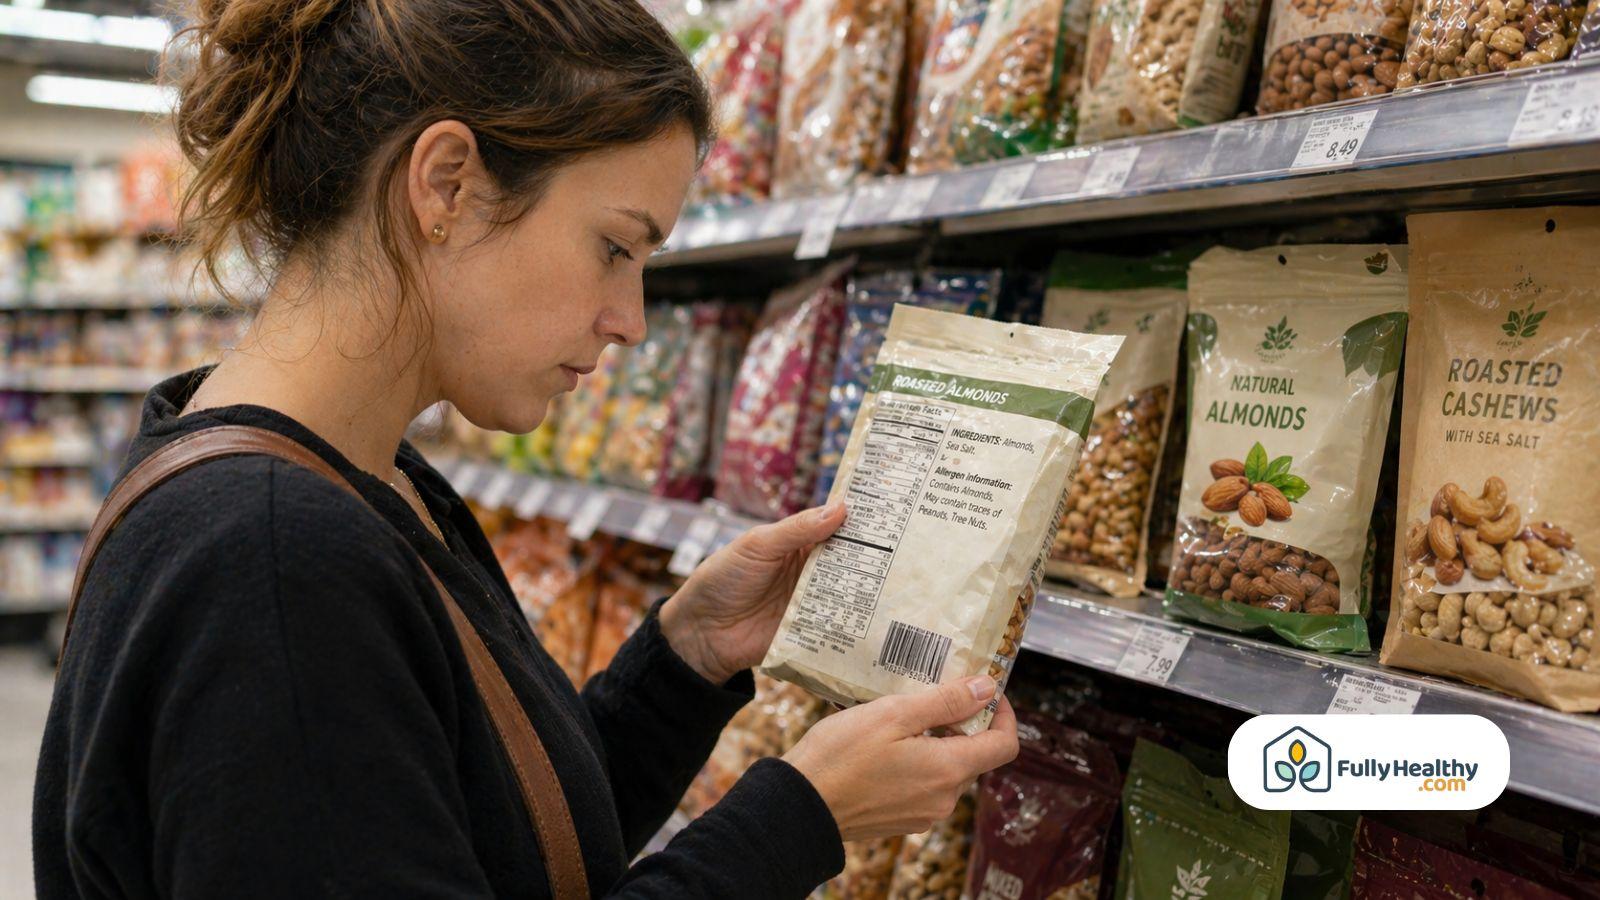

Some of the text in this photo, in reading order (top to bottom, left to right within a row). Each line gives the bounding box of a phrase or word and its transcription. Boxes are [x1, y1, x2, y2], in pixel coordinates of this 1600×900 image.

[1326, 138, 1359, 158] 8.49
[1448, 358, 1563, 388] ROASTED
[892, 375, 1010, 405] ROASTED ALMONDS
[1230, 375, 1295, 396] NATURAL
[1205, 399, 1308, 431] ALMONDS
[1442, 391, 1559, 424] CASHEWS
[946, 441, 976, 455] Sea Salt.
[951, 428, 1035, 454] INGREDIENTS: Almonds,
[1445, 429, 1542, 449] WITH SEA SALT
[935, 466, 965, 480] Allergen
[929, 479, 994, 502] Contains Almonds,
[919, 505, 988, 530] Peanuts, Tree Nuts.
[923, 492, 940, 504] May
[940, 497, 967, 510] contain
[968, 502, 991, 516] traces
[992, 508, 1003, 519] of
[1146, 654, 1173, 675] 7.99
